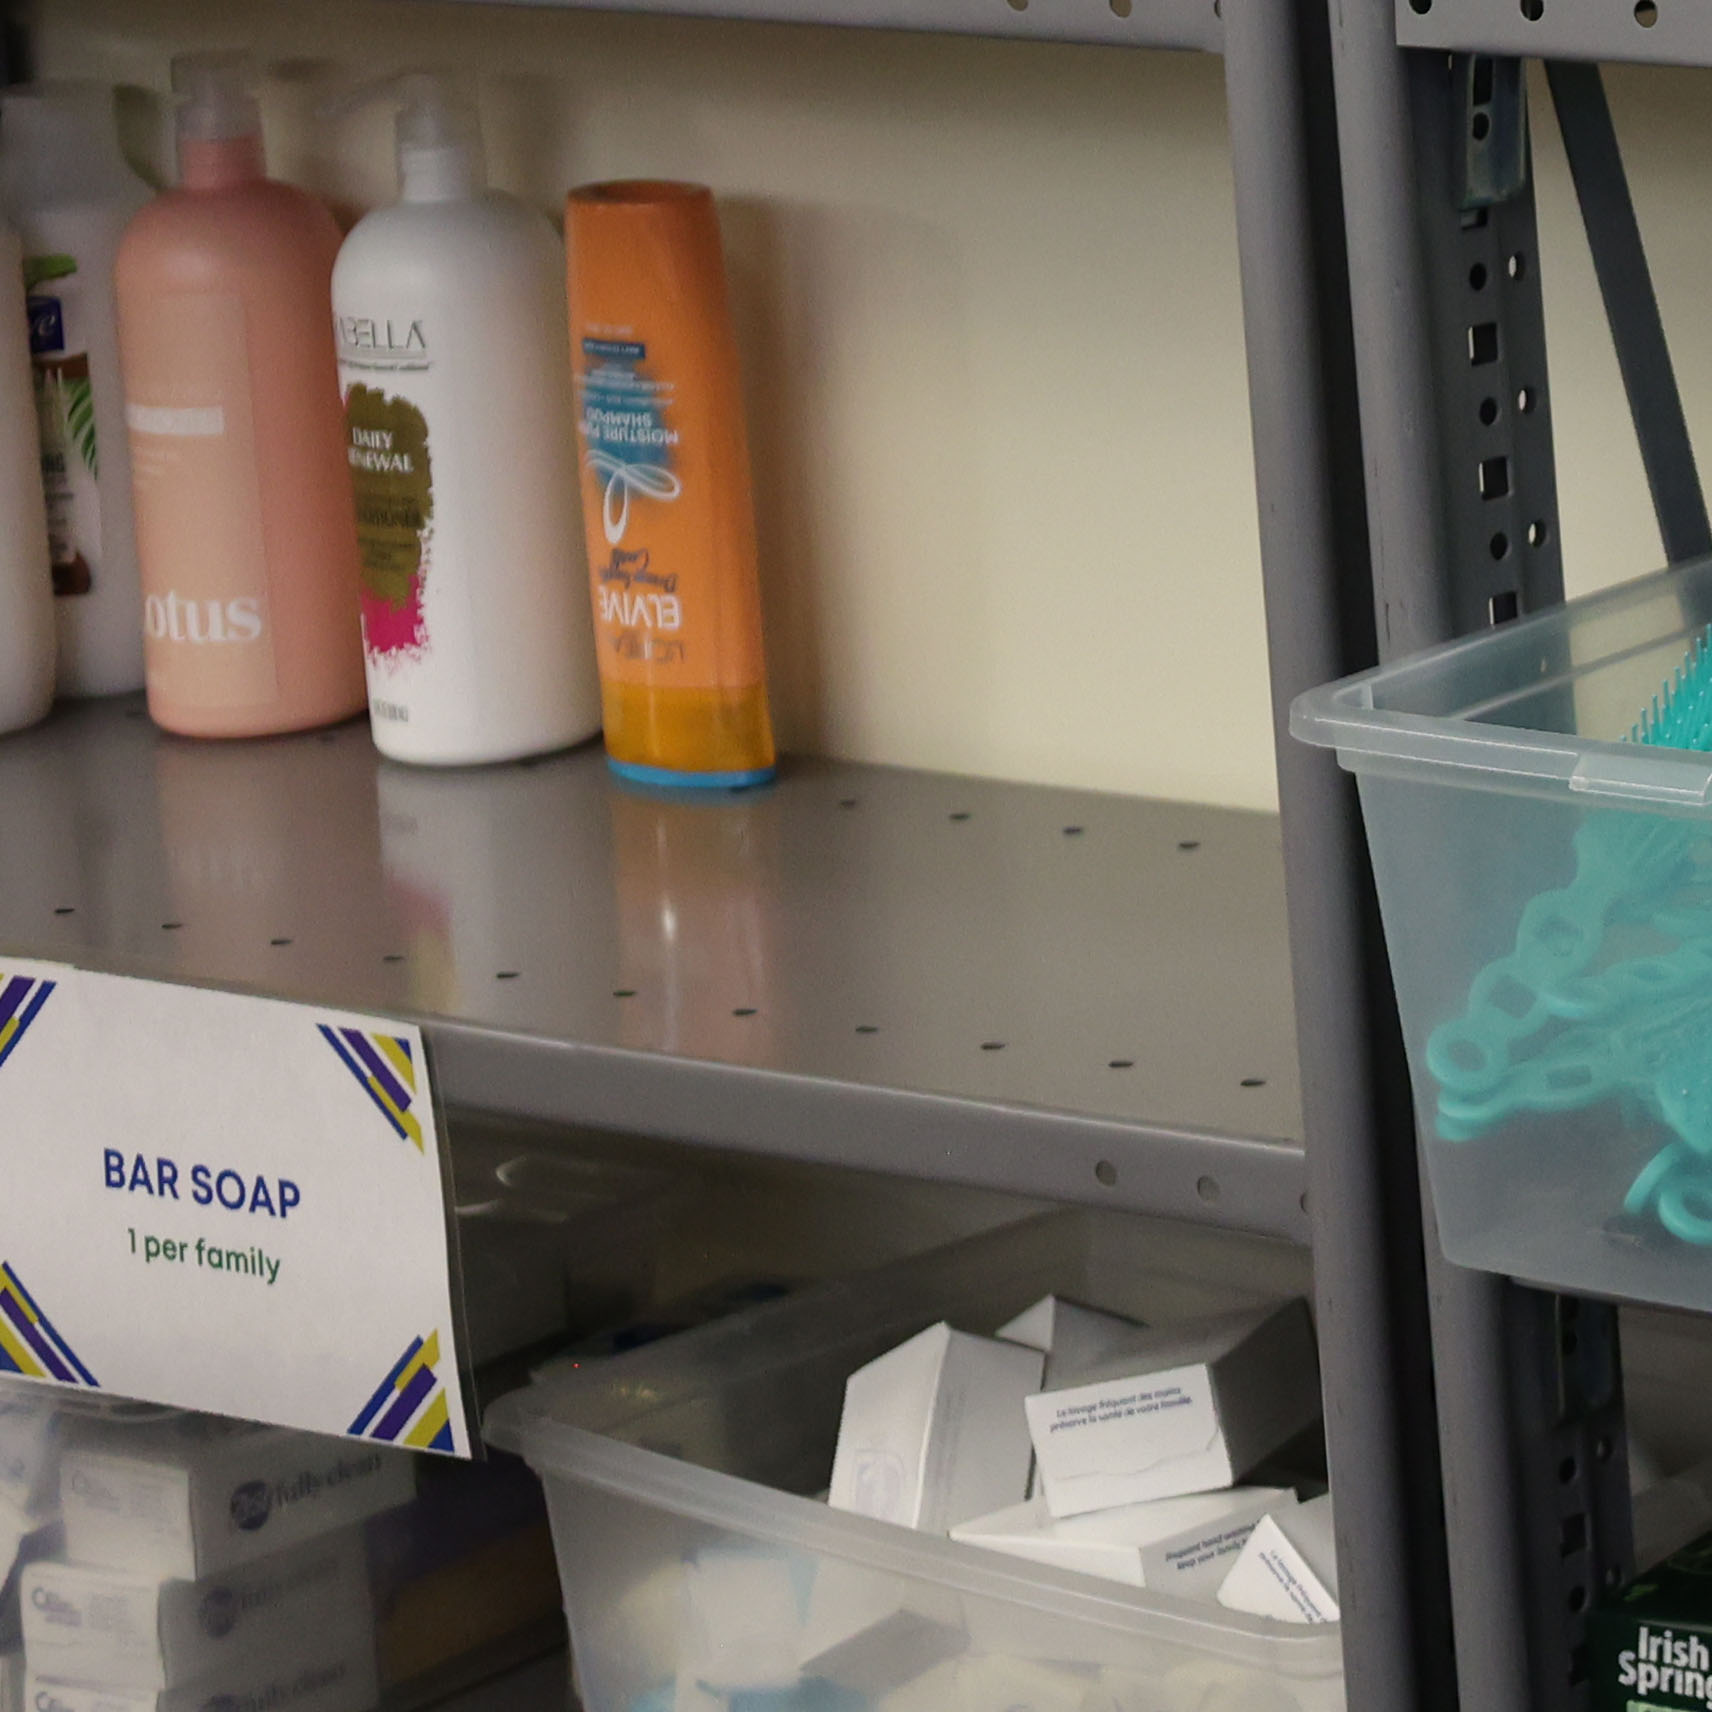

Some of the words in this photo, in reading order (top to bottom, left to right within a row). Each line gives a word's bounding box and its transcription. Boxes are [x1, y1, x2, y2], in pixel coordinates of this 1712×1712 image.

[352, 427, 392, 451] DAILY
[103, 1147, 180, 1201] BAR
[190, 1164, 301, 1221] SOAP
[144, 1233, 187, 1269] per
[195, 1237, 281, 1286] family
[1638, 1626, 1709, 1671] Irish
